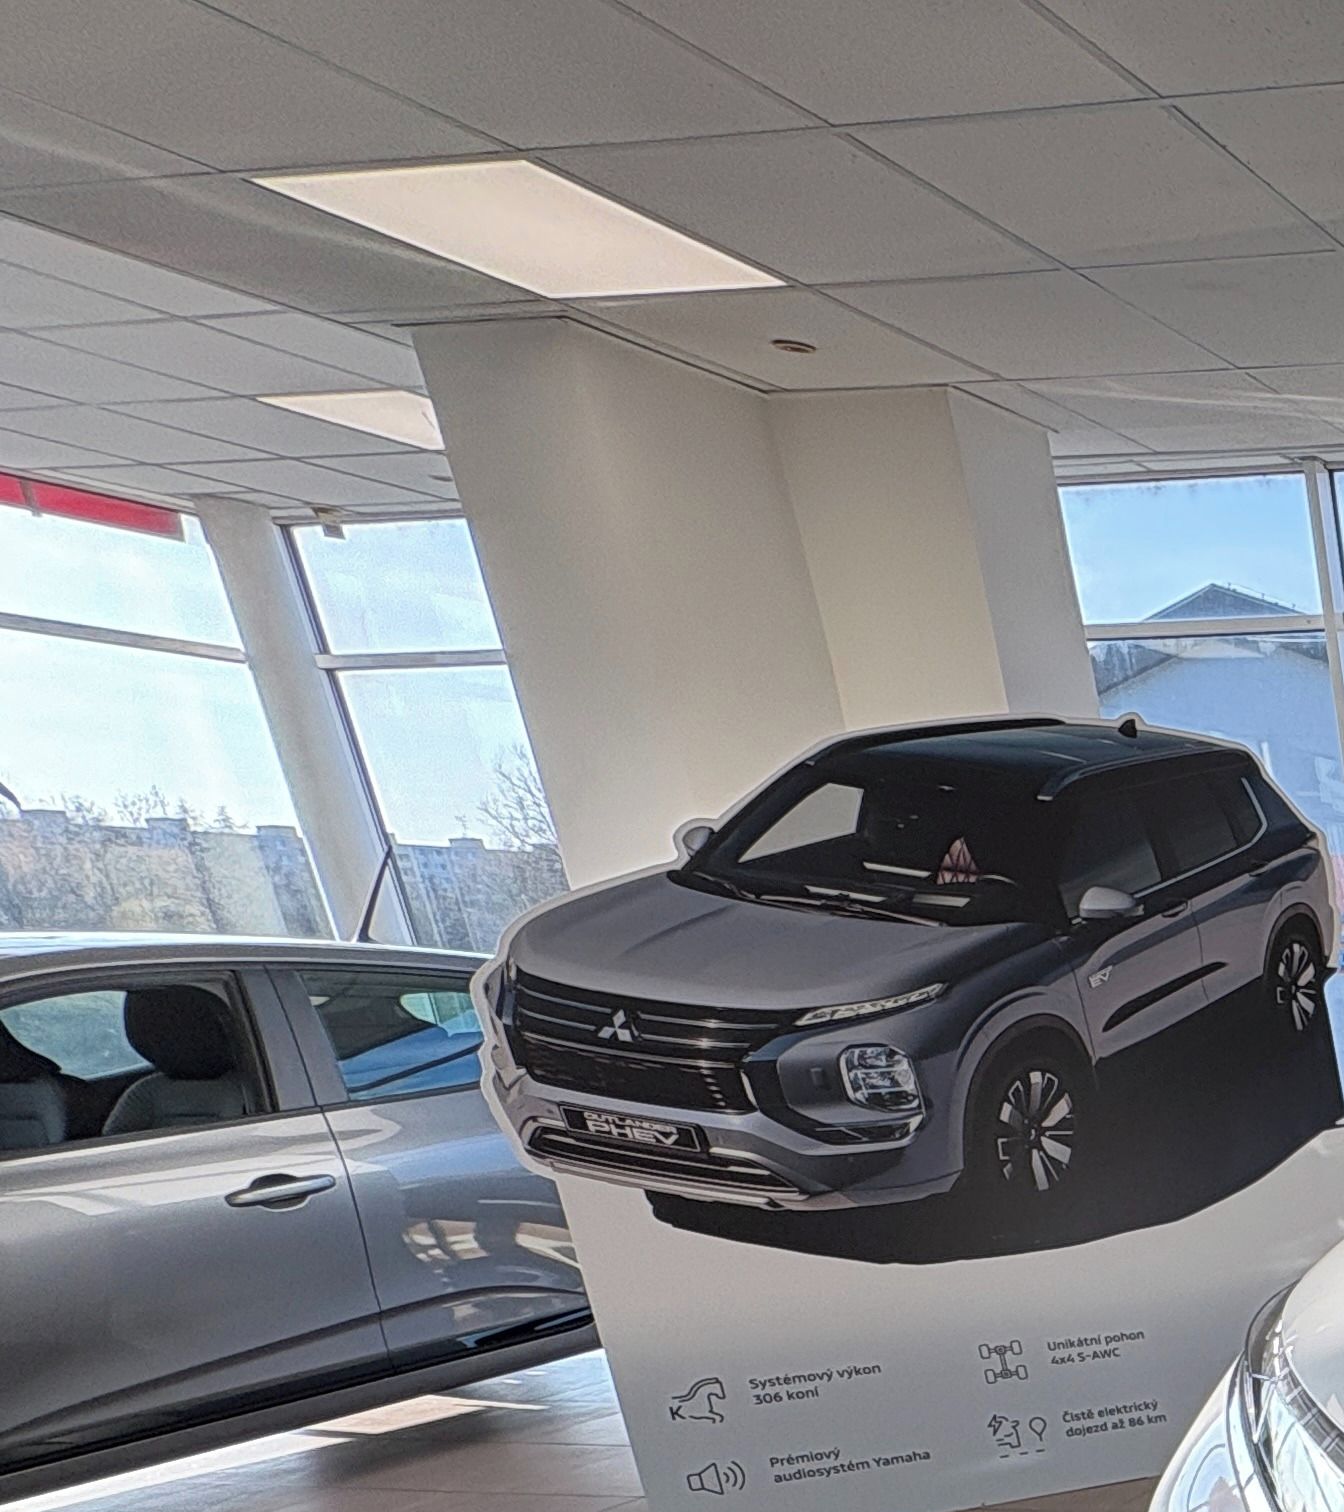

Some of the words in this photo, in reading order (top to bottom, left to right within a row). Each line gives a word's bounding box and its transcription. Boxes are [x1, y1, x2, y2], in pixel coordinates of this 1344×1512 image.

[583, 1111, 677, 1135] OUTLANDER
[587, 1120, 680, 1145] PHEV
[1047, 1336, 1101, 1352] Unikátní
[1104, 1330, 1144, 1345] pohon
[1050, 1353, 1075, 1366] 4x4
[1077, 1347, 1121, 1363] S-AWC
[750, 1368, 834, 1390] Systémový
[836, 1363, 881, 1381] výkon
[753, 1391, 783, 1405] 306
[788, 1386, 819, 1401] koní
[1062, 1408, 1096, 1424] Čistě
[1098, 1400, 1158, 1417] elektrický
[1066, 1423, 1108, 1438] dojezd
[1110, 1419, 1126, 1431] až
[1128, 1417, 1145, 1428] 86
[1148, 1413, 1167, 1425] km
[770, 1448, 841, 1467] Prémiový
[773, 1462, 870, 1484] audiosystém
[872, 1450, 930, 1467] Yamaha
